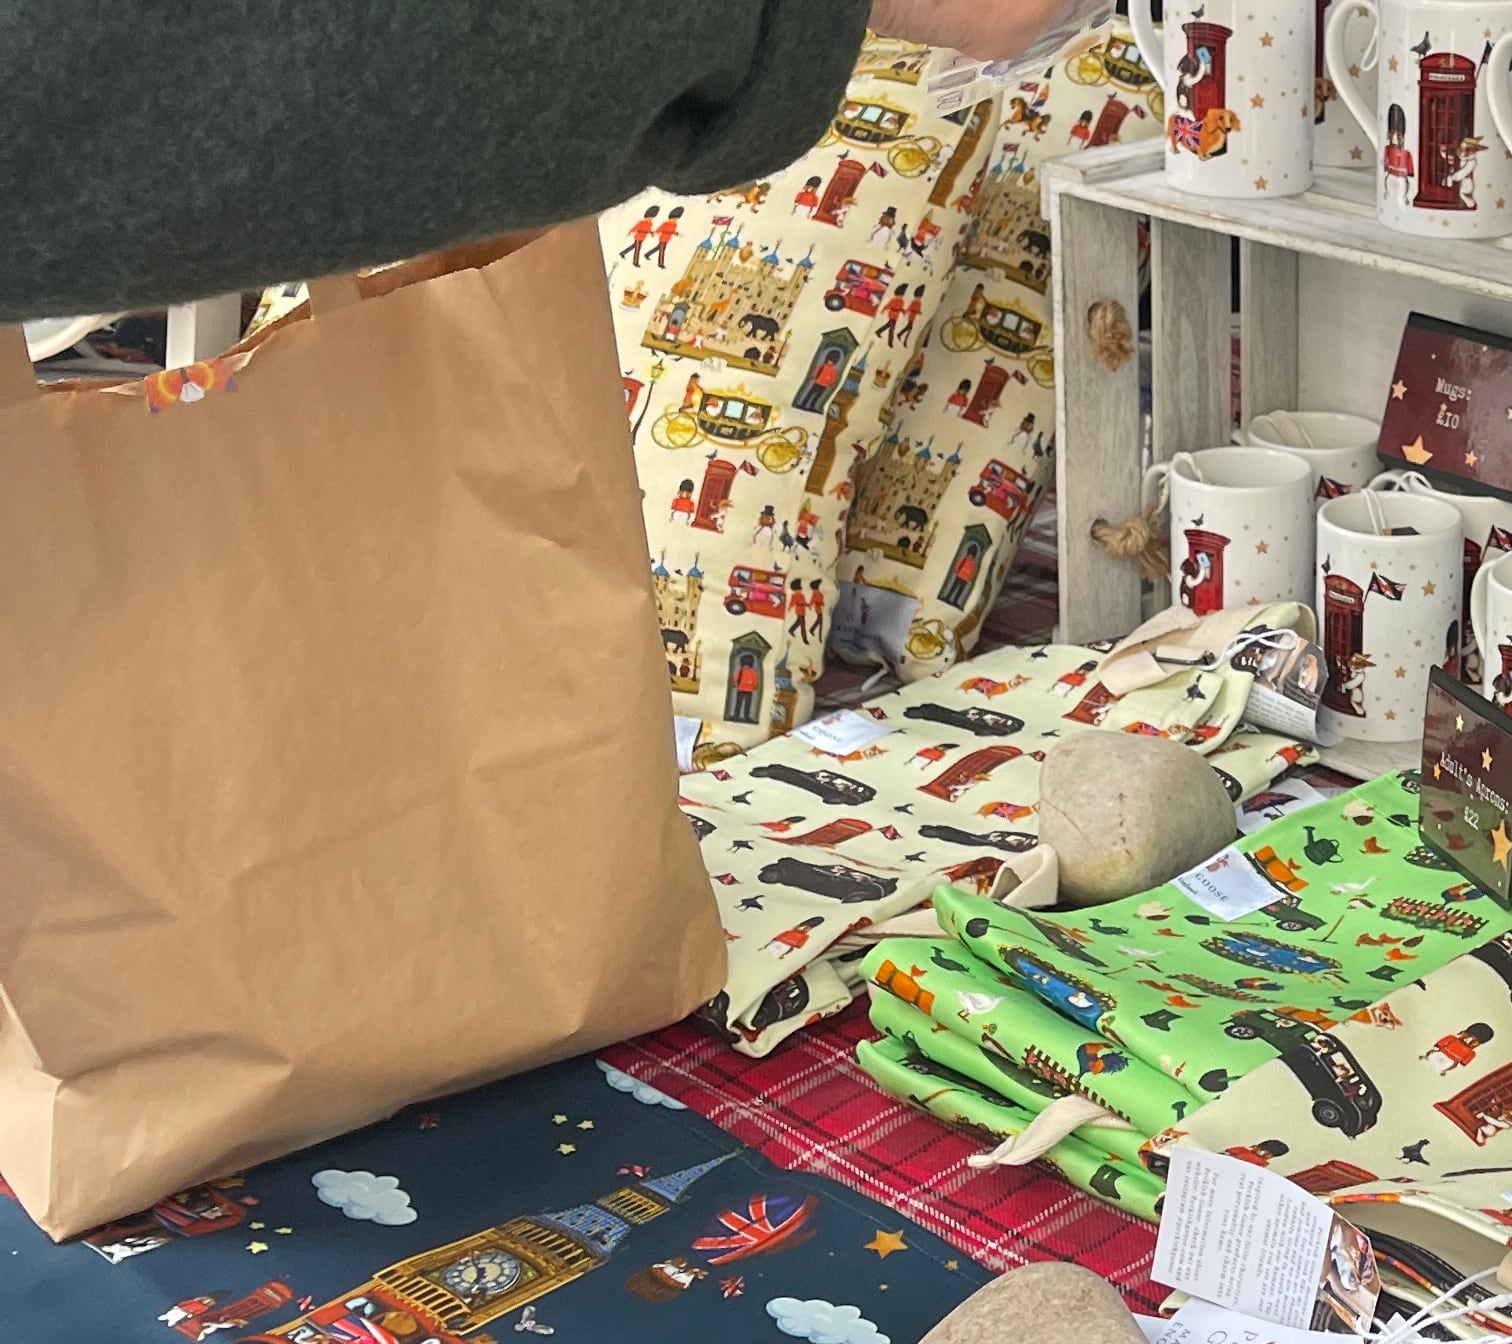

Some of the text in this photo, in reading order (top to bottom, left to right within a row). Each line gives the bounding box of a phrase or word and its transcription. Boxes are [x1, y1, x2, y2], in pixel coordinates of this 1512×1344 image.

[1435, 377, 1473, 402] Mugs:
[1475, 777, 1510, 815] Aprons:
[1195, 873, 1229, 902] GOOSE
